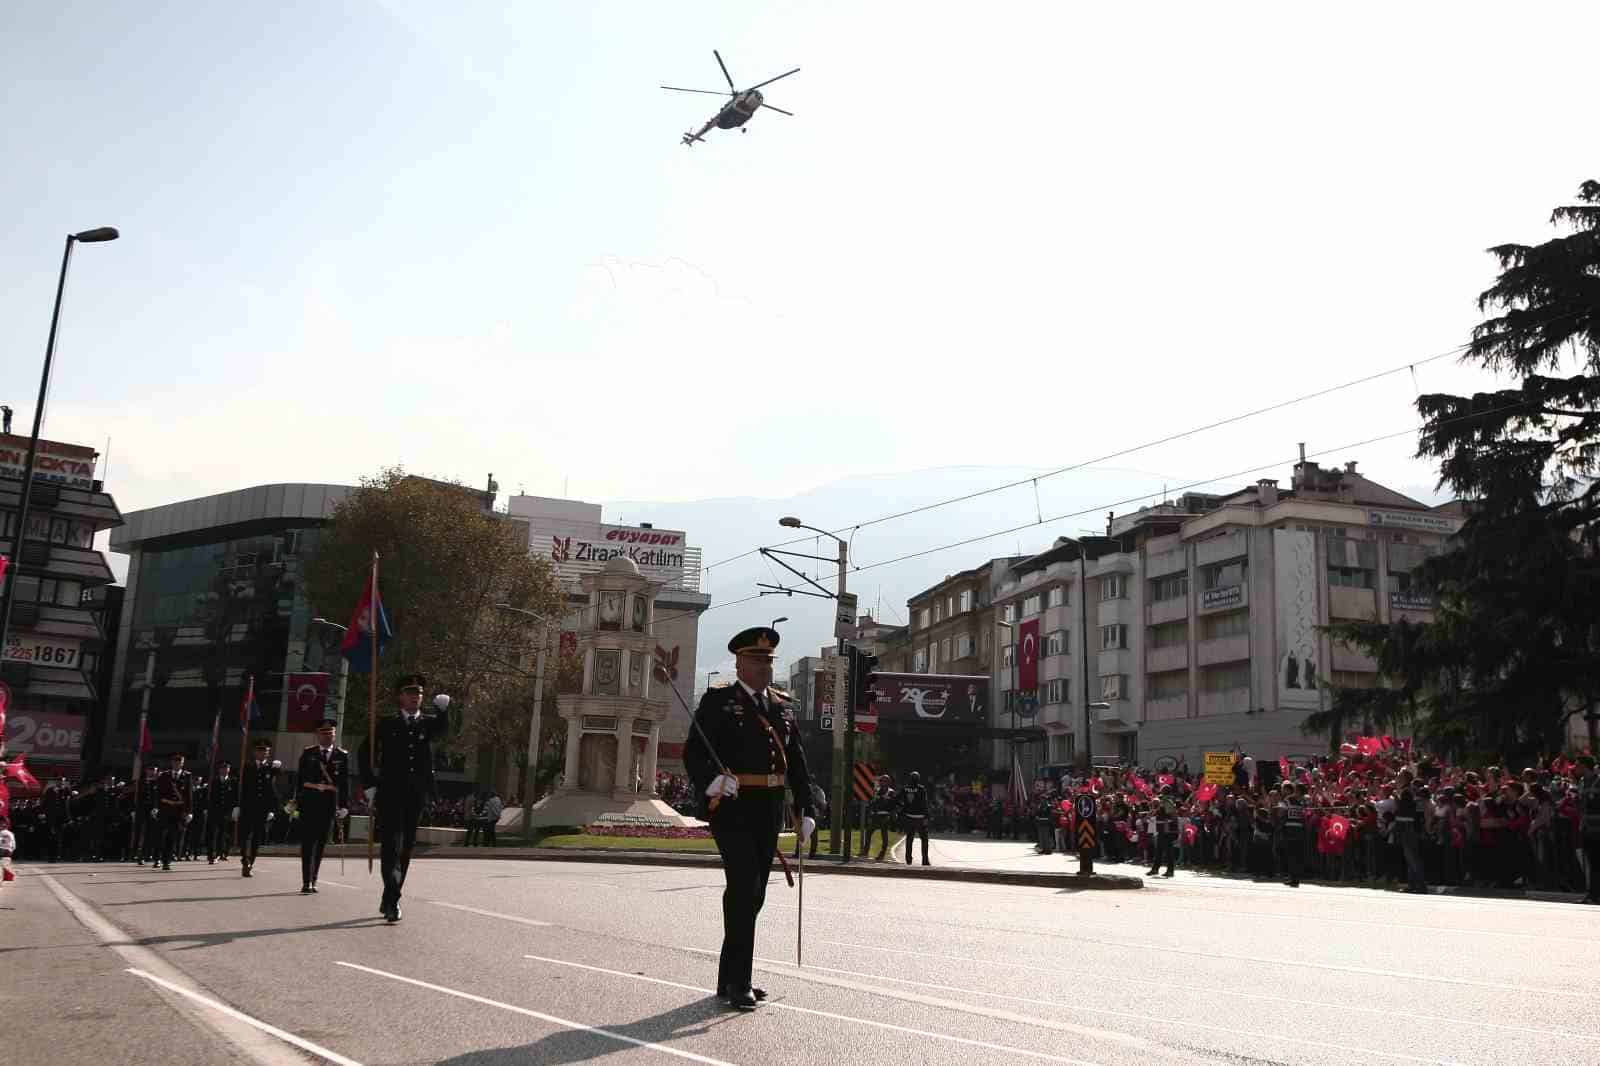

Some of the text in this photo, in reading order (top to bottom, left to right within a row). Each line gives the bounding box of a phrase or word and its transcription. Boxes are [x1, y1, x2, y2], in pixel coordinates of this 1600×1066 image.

[606, 528, 681, 545] evyapar
[575, 542, 683, 568] Ziraat Katılım
[34, 645, 76, 664] 1867
[36, 722, 81, 748] ÖDE
